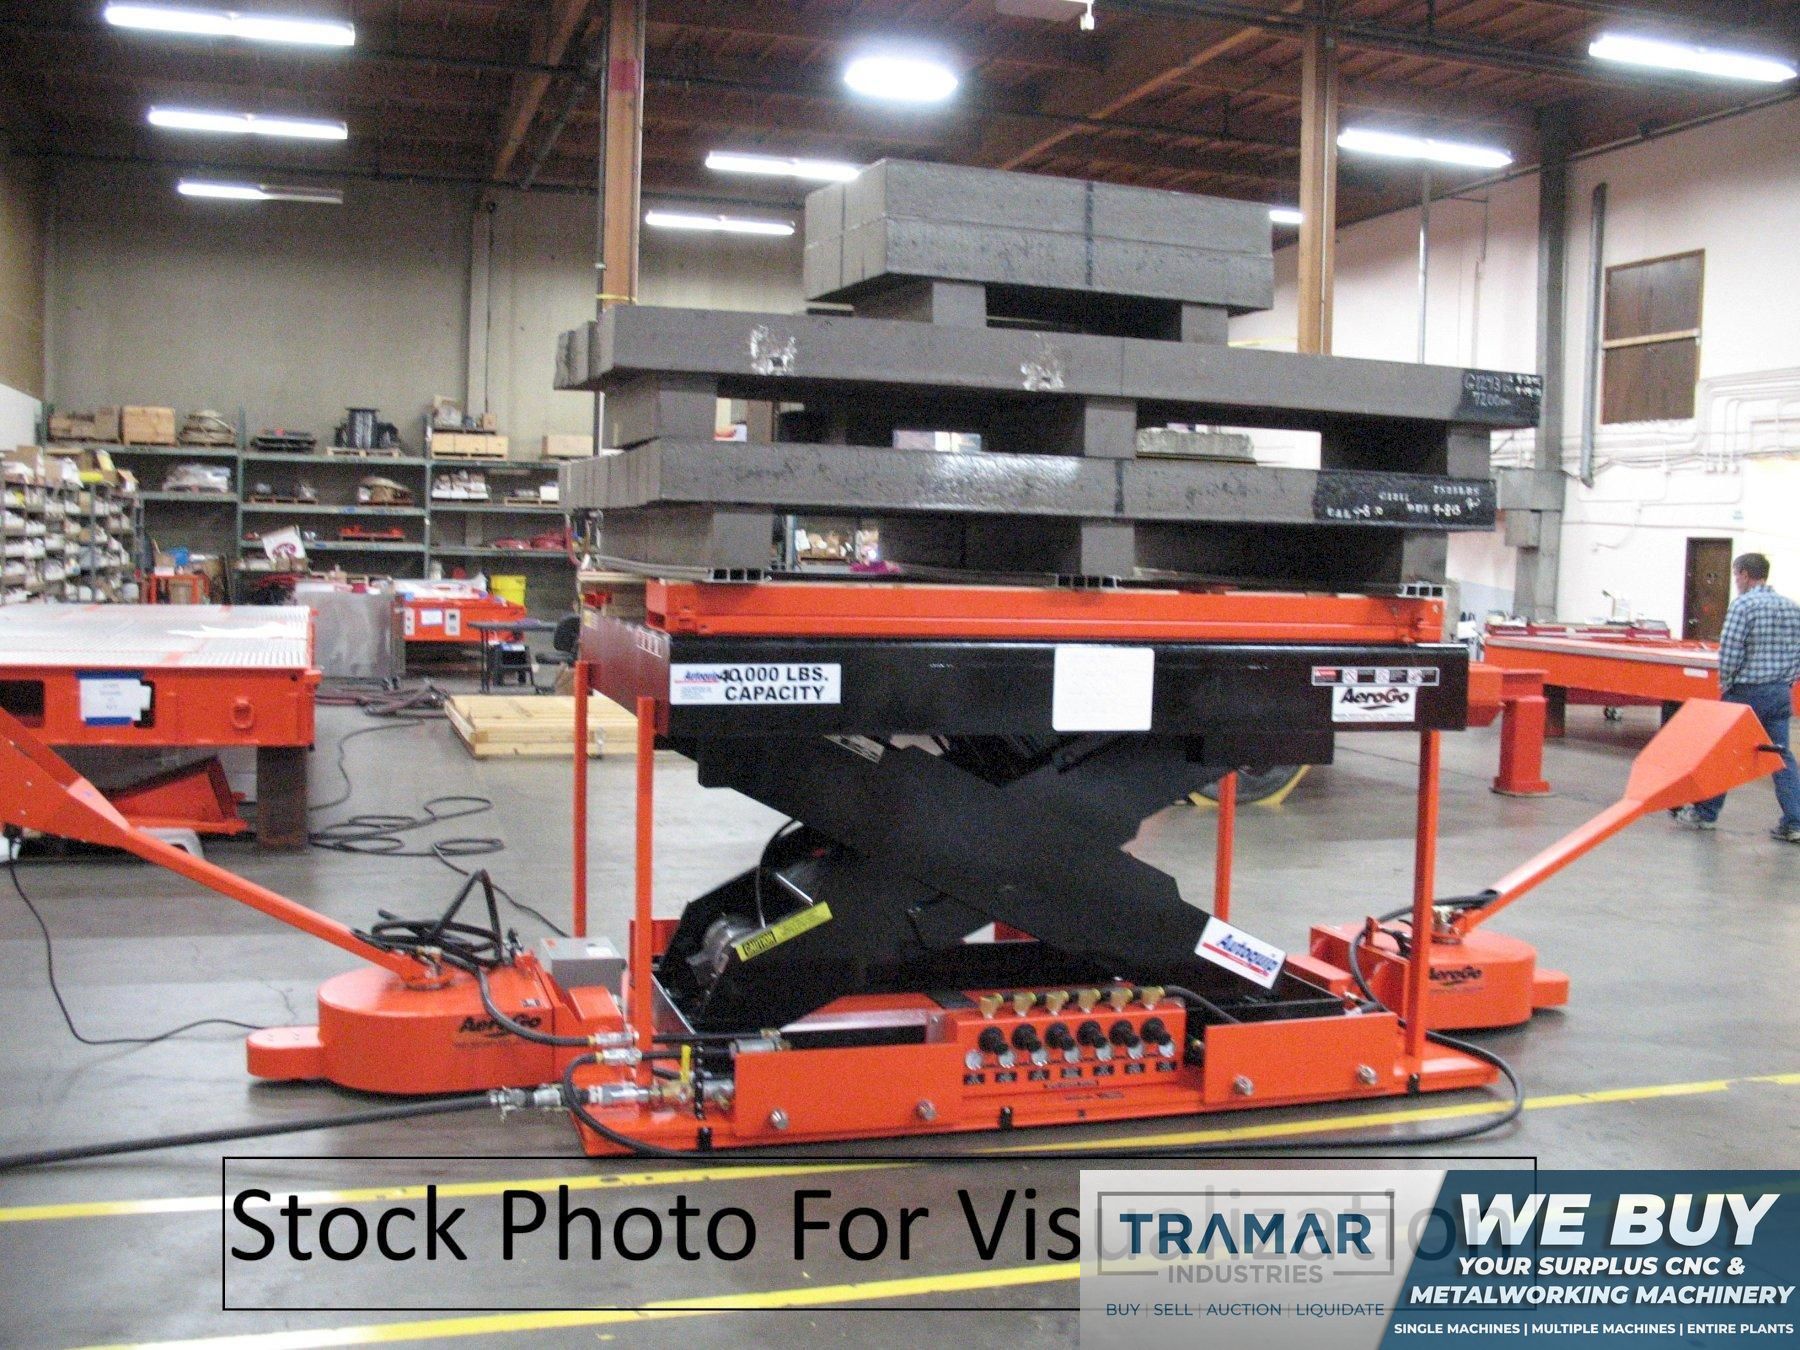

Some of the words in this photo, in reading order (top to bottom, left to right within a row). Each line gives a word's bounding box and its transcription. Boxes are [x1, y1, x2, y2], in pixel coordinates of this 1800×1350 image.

[787, 667, 828, 681] LBS.
[725, 686, 824, 701] CAPACITY
[1341, 688, 1410, 704] AeroGo
